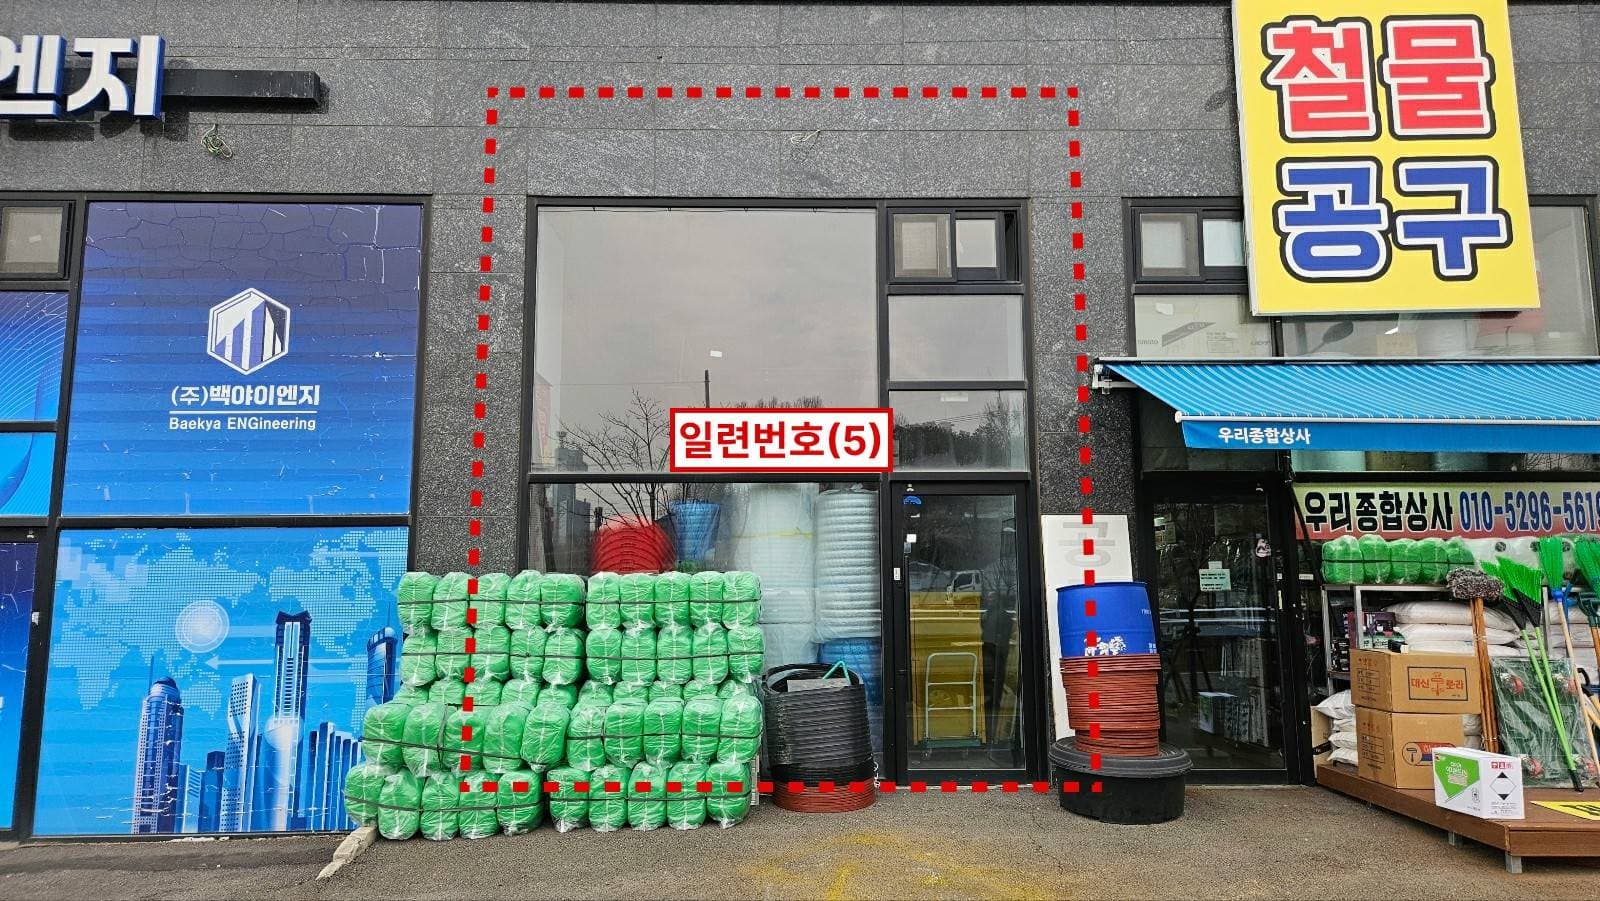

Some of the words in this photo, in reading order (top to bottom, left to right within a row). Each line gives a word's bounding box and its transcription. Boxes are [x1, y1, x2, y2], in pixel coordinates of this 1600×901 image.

[0, 34, 165, 120] 엔지
[1261, 14, 1496, 143] 철물
[1272, 155, 1513, 283] 공구
[171, 384, 320, 407] (주)백야이엔지
[169, 416, 222, 432] Baekya
[227, 416, 316, 431] ENGineering
[1217, 426, 1311, 445] 우리종합상사
[1304, 490, 1453, 532] 우리종합상사
[1411, 678, 1430, 689] 대신
